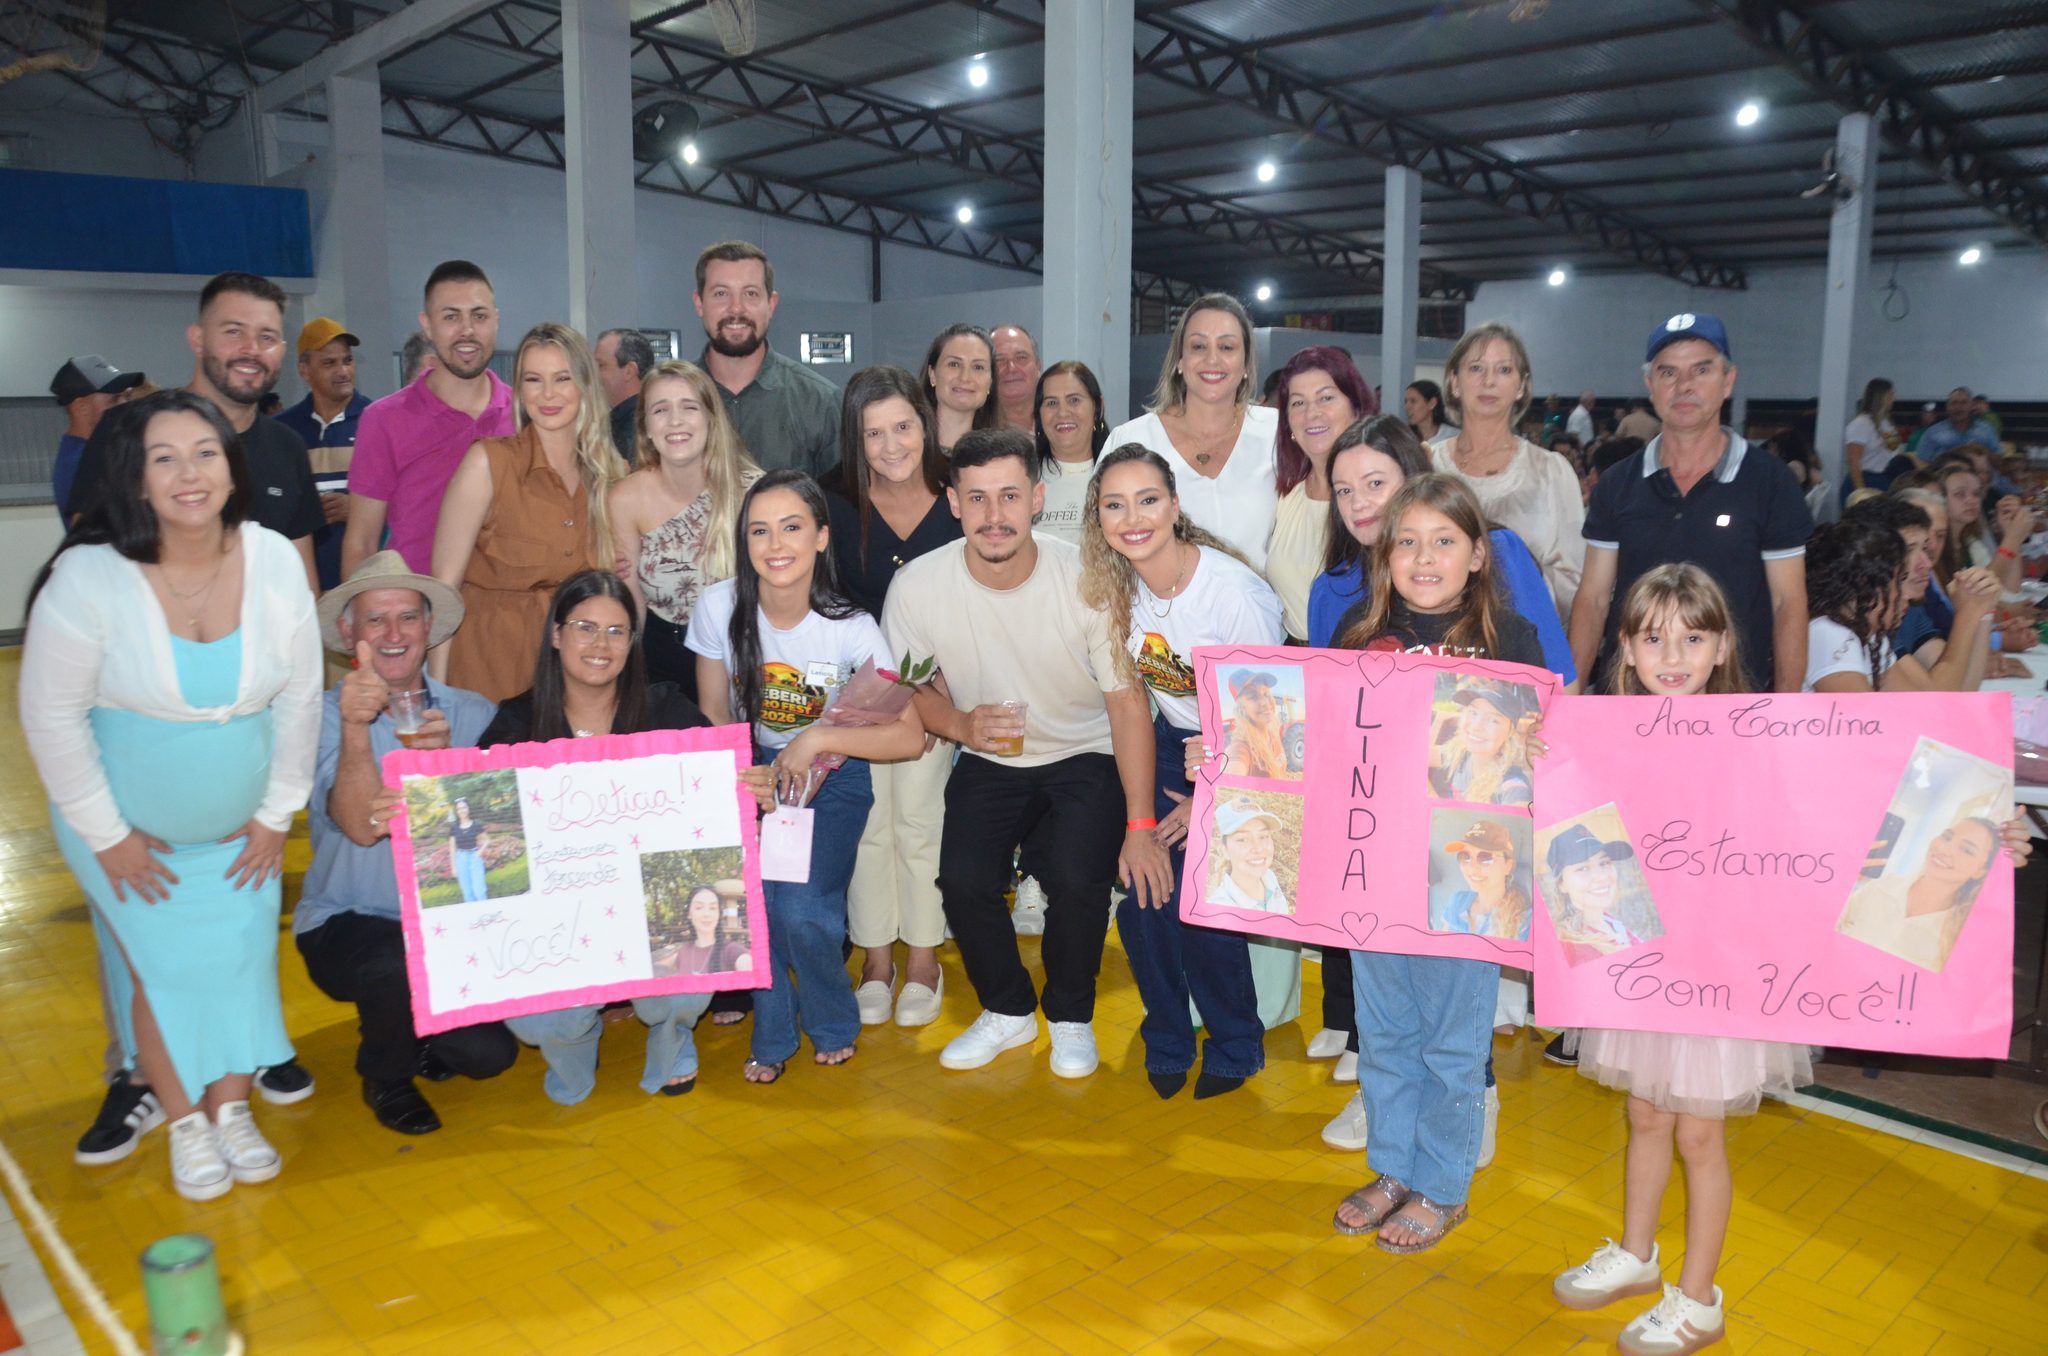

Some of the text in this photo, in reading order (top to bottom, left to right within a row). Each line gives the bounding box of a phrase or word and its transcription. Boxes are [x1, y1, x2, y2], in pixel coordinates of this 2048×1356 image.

[1040, 511, 1078, 521] OFFEE
[762, 700, 813, 715] RO FEST
[763, 688, 807, 706] EBERI
[760, 710, 796, 723] 2026
[1636, 696, 1884, 738] Ana Carolina
[1341, 686, 1382, 892] LINDA
[1640, 820, 1835, 883] Estamos
[1607, 952, 1731, 1011] Com
